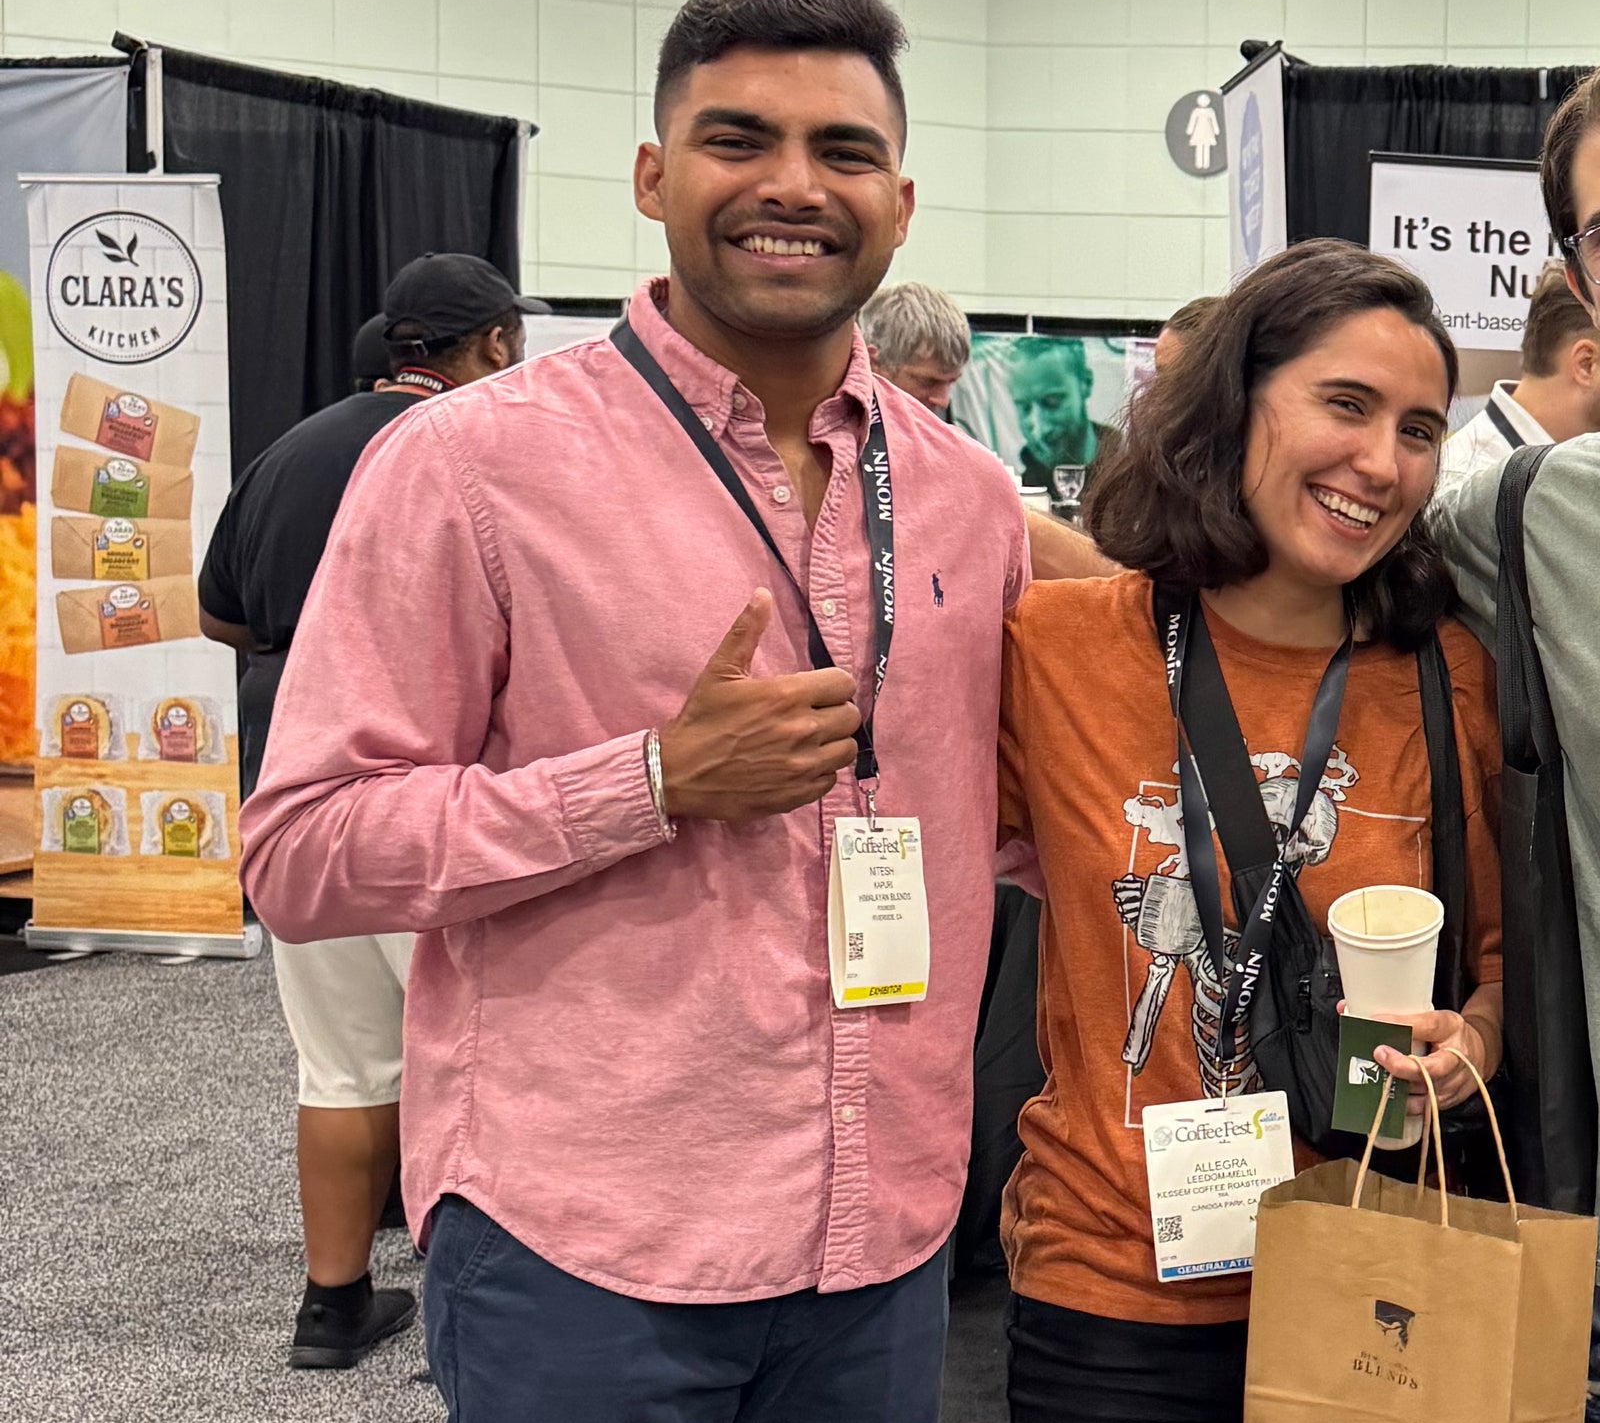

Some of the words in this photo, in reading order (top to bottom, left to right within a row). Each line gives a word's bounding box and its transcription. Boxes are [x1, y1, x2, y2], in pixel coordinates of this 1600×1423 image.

[1467, 220, 1531, 255] the
[88, 324, 161, 349] KITCHEN
[396, 372, 444, 392] Canon
[865, 449, 893, 521] MONIN
[874, 550, 895, 625] MONIN
[1166, 613, 1182, 685] MONIN
[868, 984, 903, 997] EXHIBITOR
[1231, 951, 1265, 1023] MONIN
[1194, 1157, 1249, 1174] ALLEGRA
[1157, 1187, 1192, 1199] KESSEM
[1192, 1182, 1227, 1195] COFFEE
[1227, 1178, 1273, 1191] ROASTERS
[1176, 1261, 1226, 1276] GENERAL
